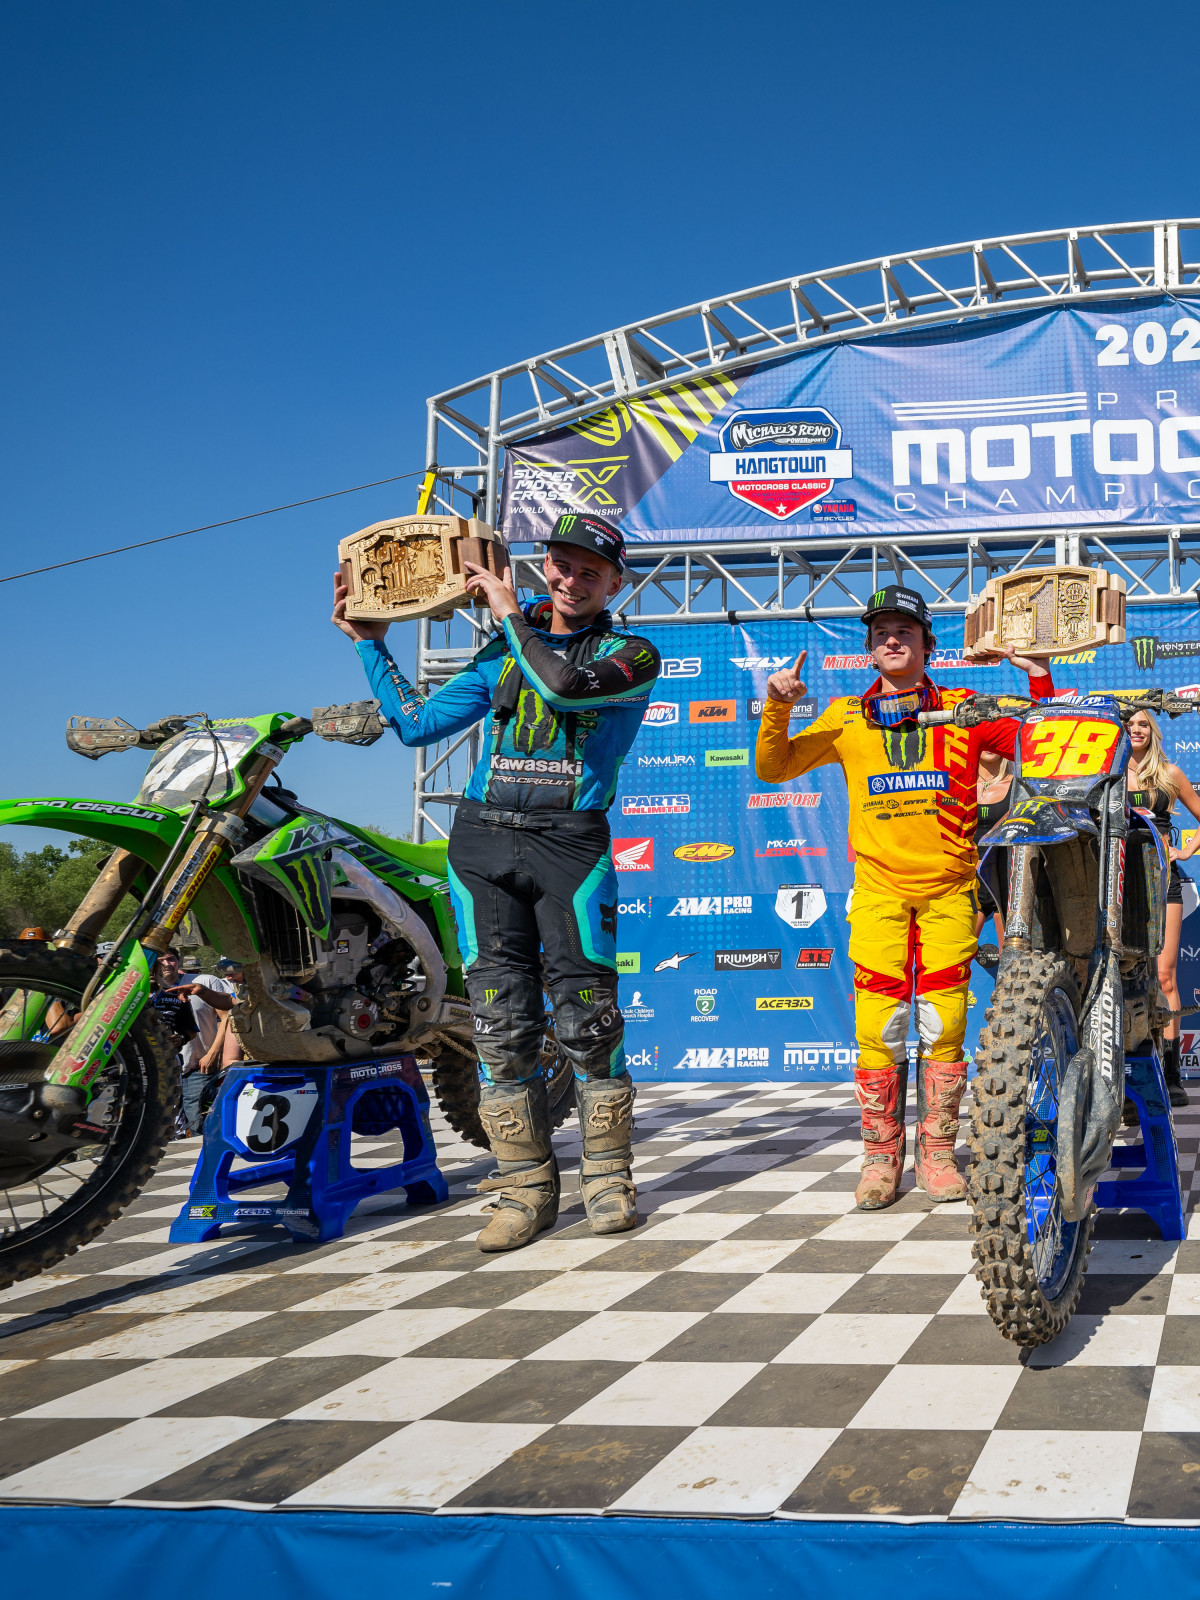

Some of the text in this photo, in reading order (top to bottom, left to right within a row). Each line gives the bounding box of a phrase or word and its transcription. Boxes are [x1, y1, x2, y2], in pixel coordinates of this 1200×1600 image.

[798, 425, 831, 437] RENO
[735, 456, 827, 475] HANGTOWN
[512, 469, 577, 482] SUPER
[515, 479, 573, 491] MOTO
[737, 482, 827, 491] MOTOCROSS CLASSIC
[510, 490, 573, 501] CROSS
[822, 504, 855, 513] YAMAHA
[400, 524, 434, 535] 2024
[644, 707, 674, 720] 100%
[698, 705, 729, 718] KTM
[1021, 720, 1121, 779] 38
[638, 753, 695, 764] NAMURA
[709, 753, 744, 763] Kawasaki
[490, 754, 583, 776] Kawasaki
[492, 775, 575, 786] PRO CIRCUIT
[885, 774, 945, 790] YAMAHA
[623, 795, 690, 807] PARTS
[70, 802, 168, 822] CIRCUIT
[622, 804, 690, 815] UNLIMITED
[675, 846, 735, 860] FMF
[186, 850, 218, 900] SHOWA
[667, 896, 722, 916] AMA
[723, 895, 752, 907] PRO
[723, 906, 752, 914] RACING
[716, 952, 767, 965] TRIUMPH
[799, 950, 831, 963] ETS
[100, 970, 141, 1024] BRAKING
[118, 990, 145, 1031] PISTONS
[701, 1000, 709, 1011] 2
[758, 999, 812, 1009] ACERBIS
[1101, 977, 1115, 1081] DUNLOP
[673, 1047, 735, 1069] AMA
[737, 1047, 769, 1059] PRO
[737, 1059, 769, 1068] RACING
[350, 1063, 403, 1079] MOTOCROSS
[246, 1095, 291, 1153] 3
[1032, 1129, 1049, 1142] 38
